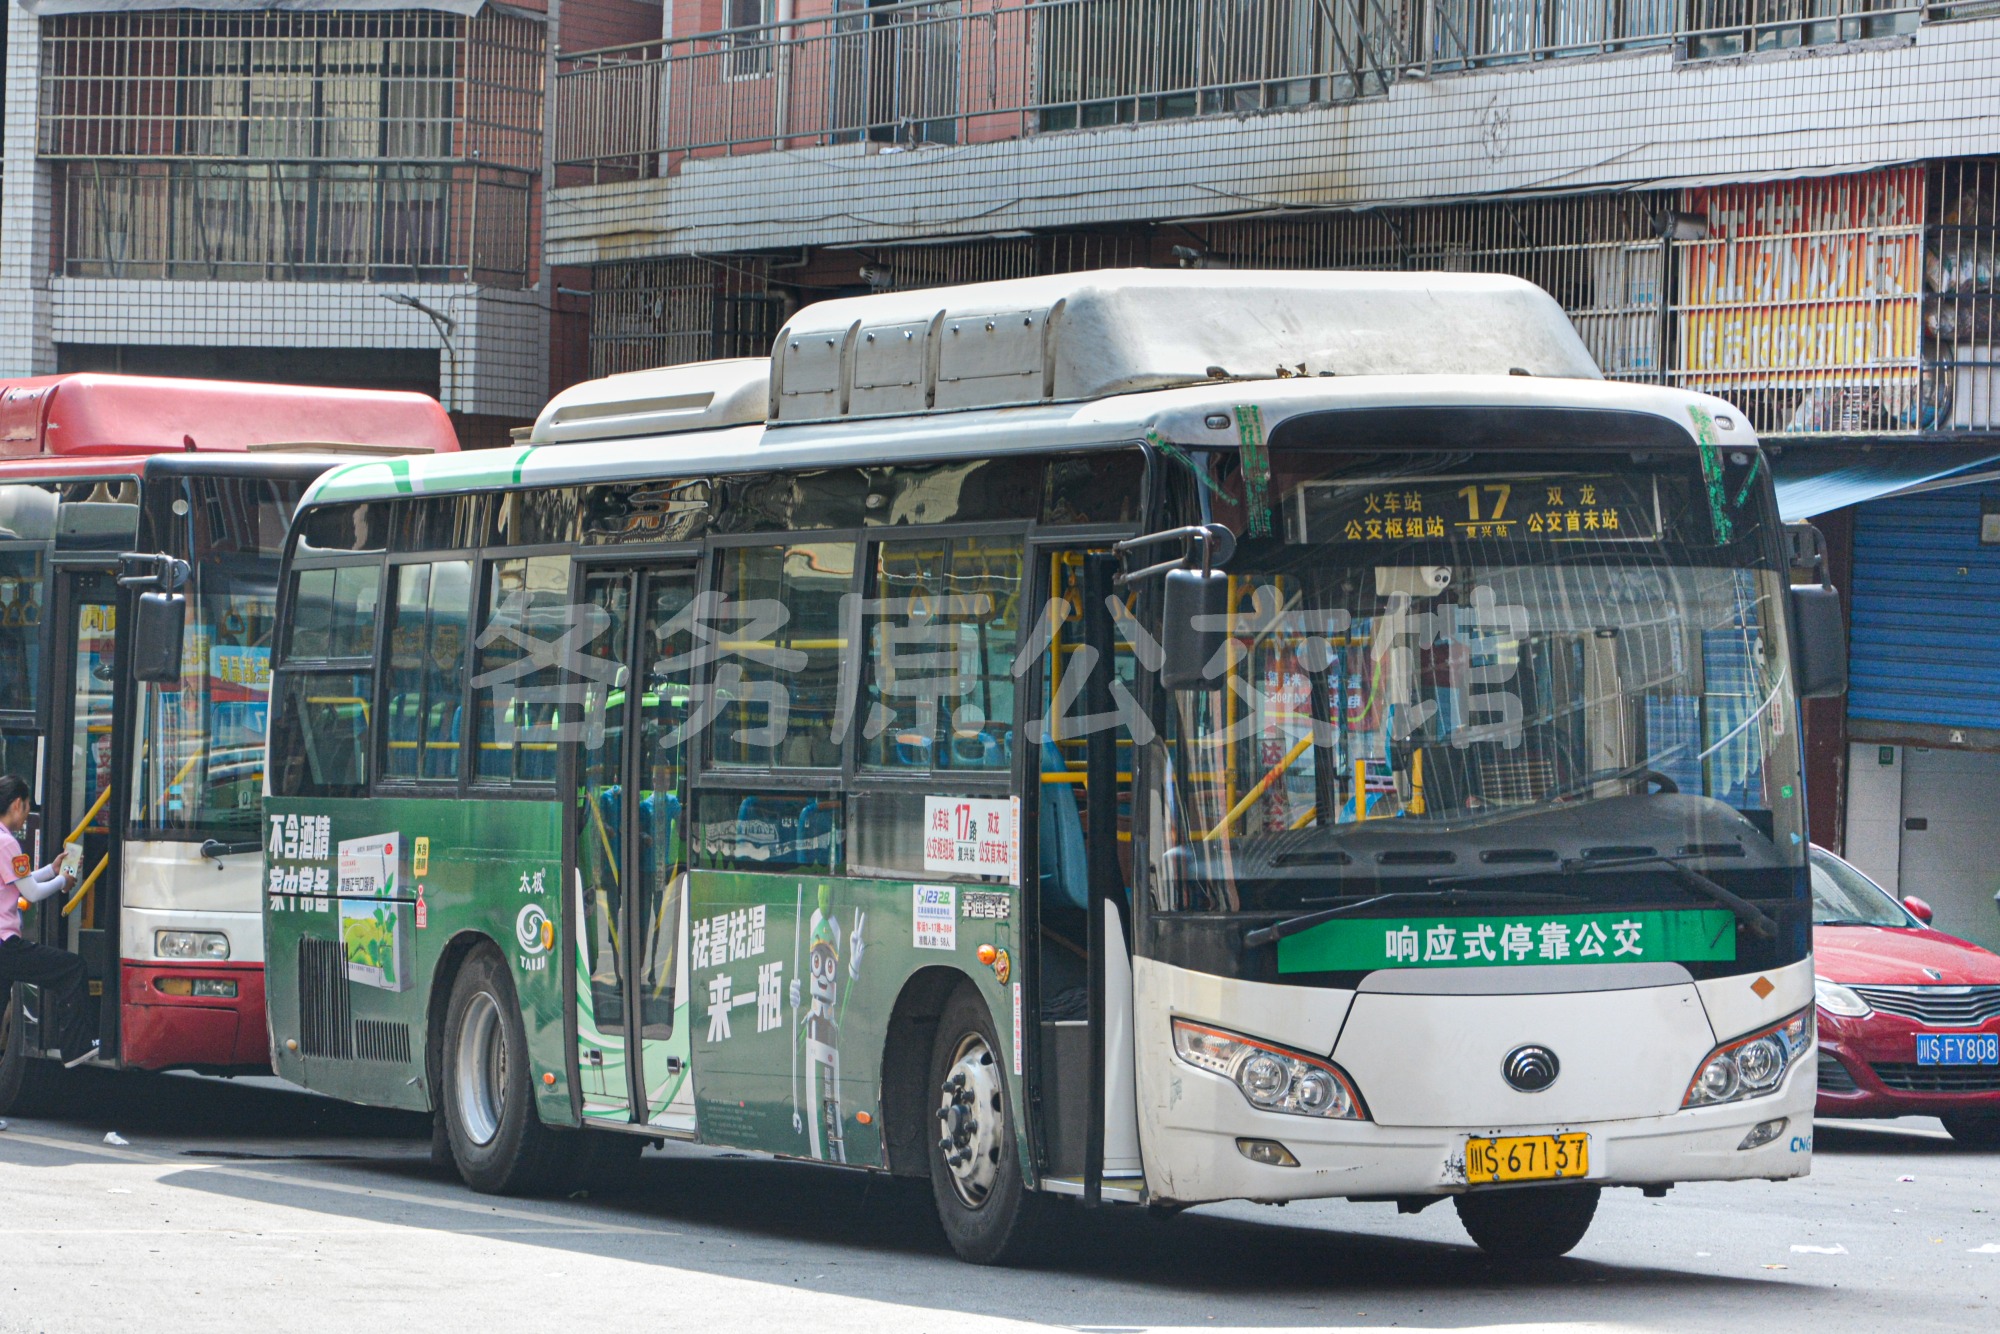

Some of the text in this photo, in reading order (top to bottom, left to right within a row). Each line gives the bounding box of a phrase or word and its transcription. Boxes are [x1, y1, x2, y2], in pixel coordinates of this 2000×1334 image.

[1364, 491, 1422, 514] 火车站
[1458, 484, 1511, 521] 17
[1547, 484, 1596, 505] 双龙
[1344, 516, 1444, 540] 公交枢纽站
[1466, 525, 1507, 539] 复兴站
[1527, 508, 1618, 533] 公交首末站
[932, 808, 949, 831] 火车站
[987, 811, 999, 834] 双龙
[269, 814, 330, 860] 不含酒精
[926, 837, 954, 860] 公交枢纽站
[958, 846, 975, 862] 复兴站
[979, 841, 1008, 864] 公交首末站
[269, 865, 329, 912] 家中常备
[519, 870, 544, 894] 太极
[925, 890, 951, 904] 12328
[692, 904, 766, 971] 祛暑祛湿
[1385, 919, 1643, 962] 响应式停靠公交
[520, 955, 545, 971] TAIJI
[706, 961, 783, 1043] 来一瓶
[1790, 1137, 1812, 1153] CNG
